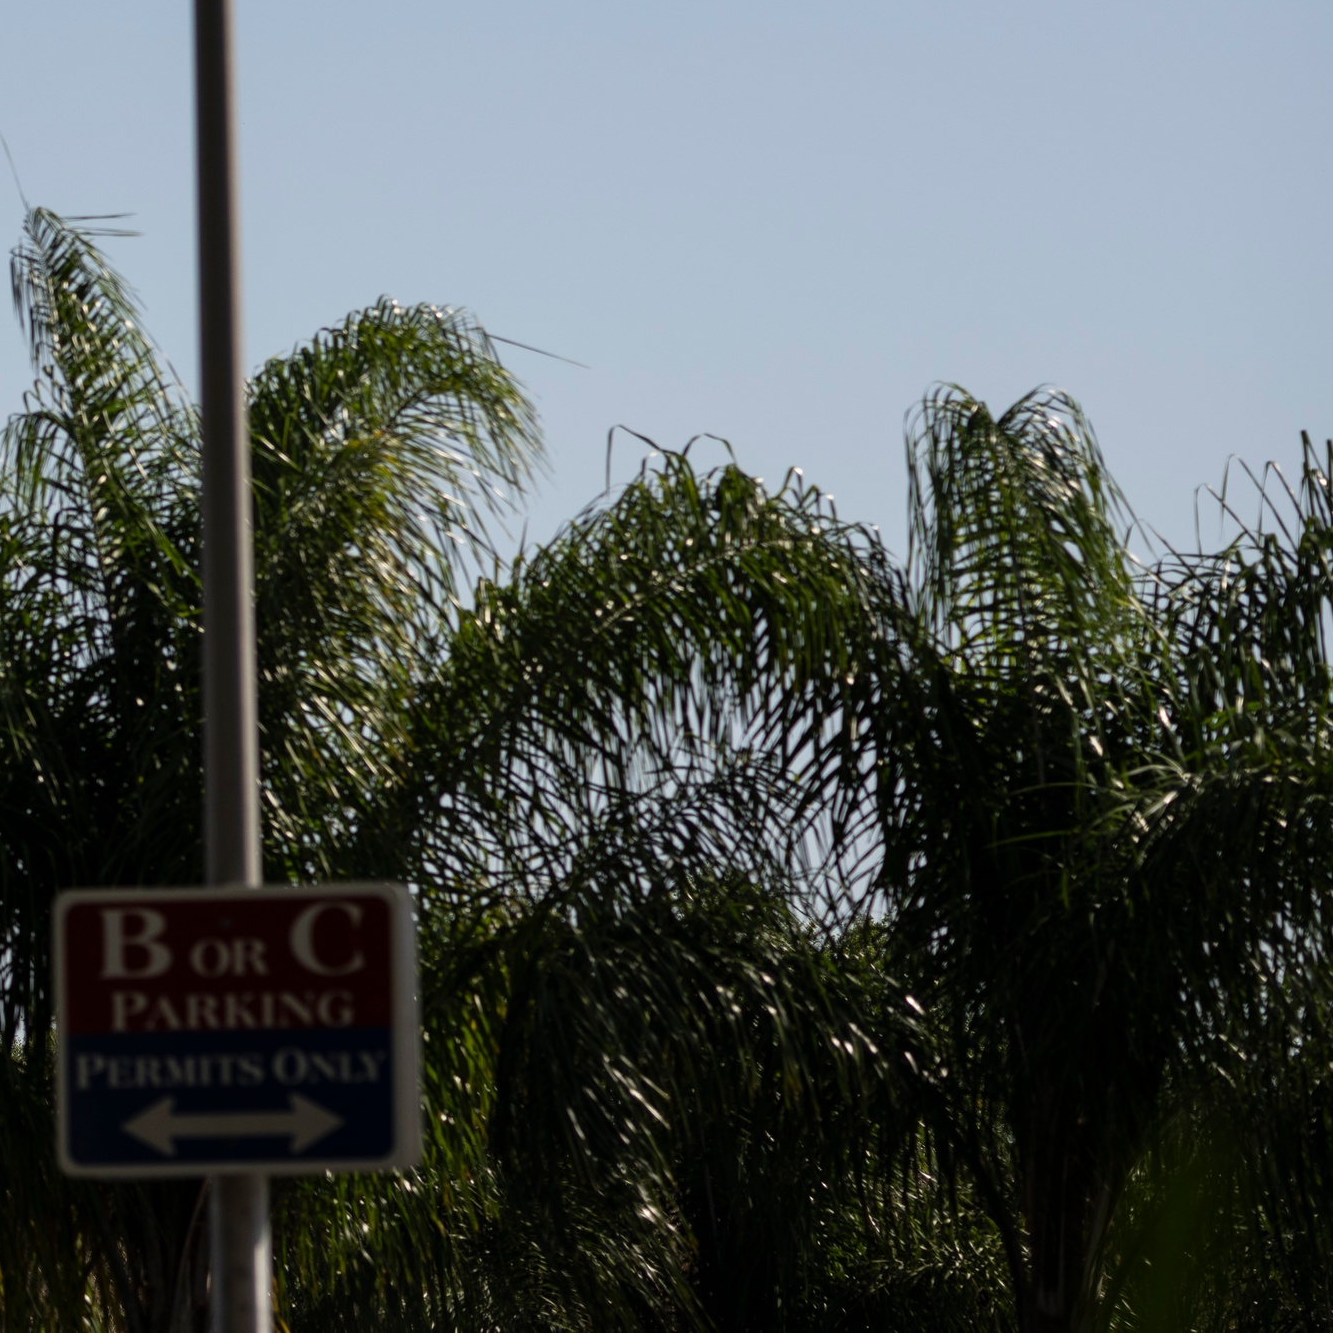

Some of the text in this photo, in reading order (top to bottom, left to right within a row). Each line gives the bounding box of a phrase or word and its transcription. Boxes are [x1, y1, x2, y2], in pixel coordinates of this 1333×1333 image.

[100, 900, 366, 980] B OR C
[111, 989, 355, 1033] PARKING
[75, 1045, 388, 1091] PERMITS ONLY
